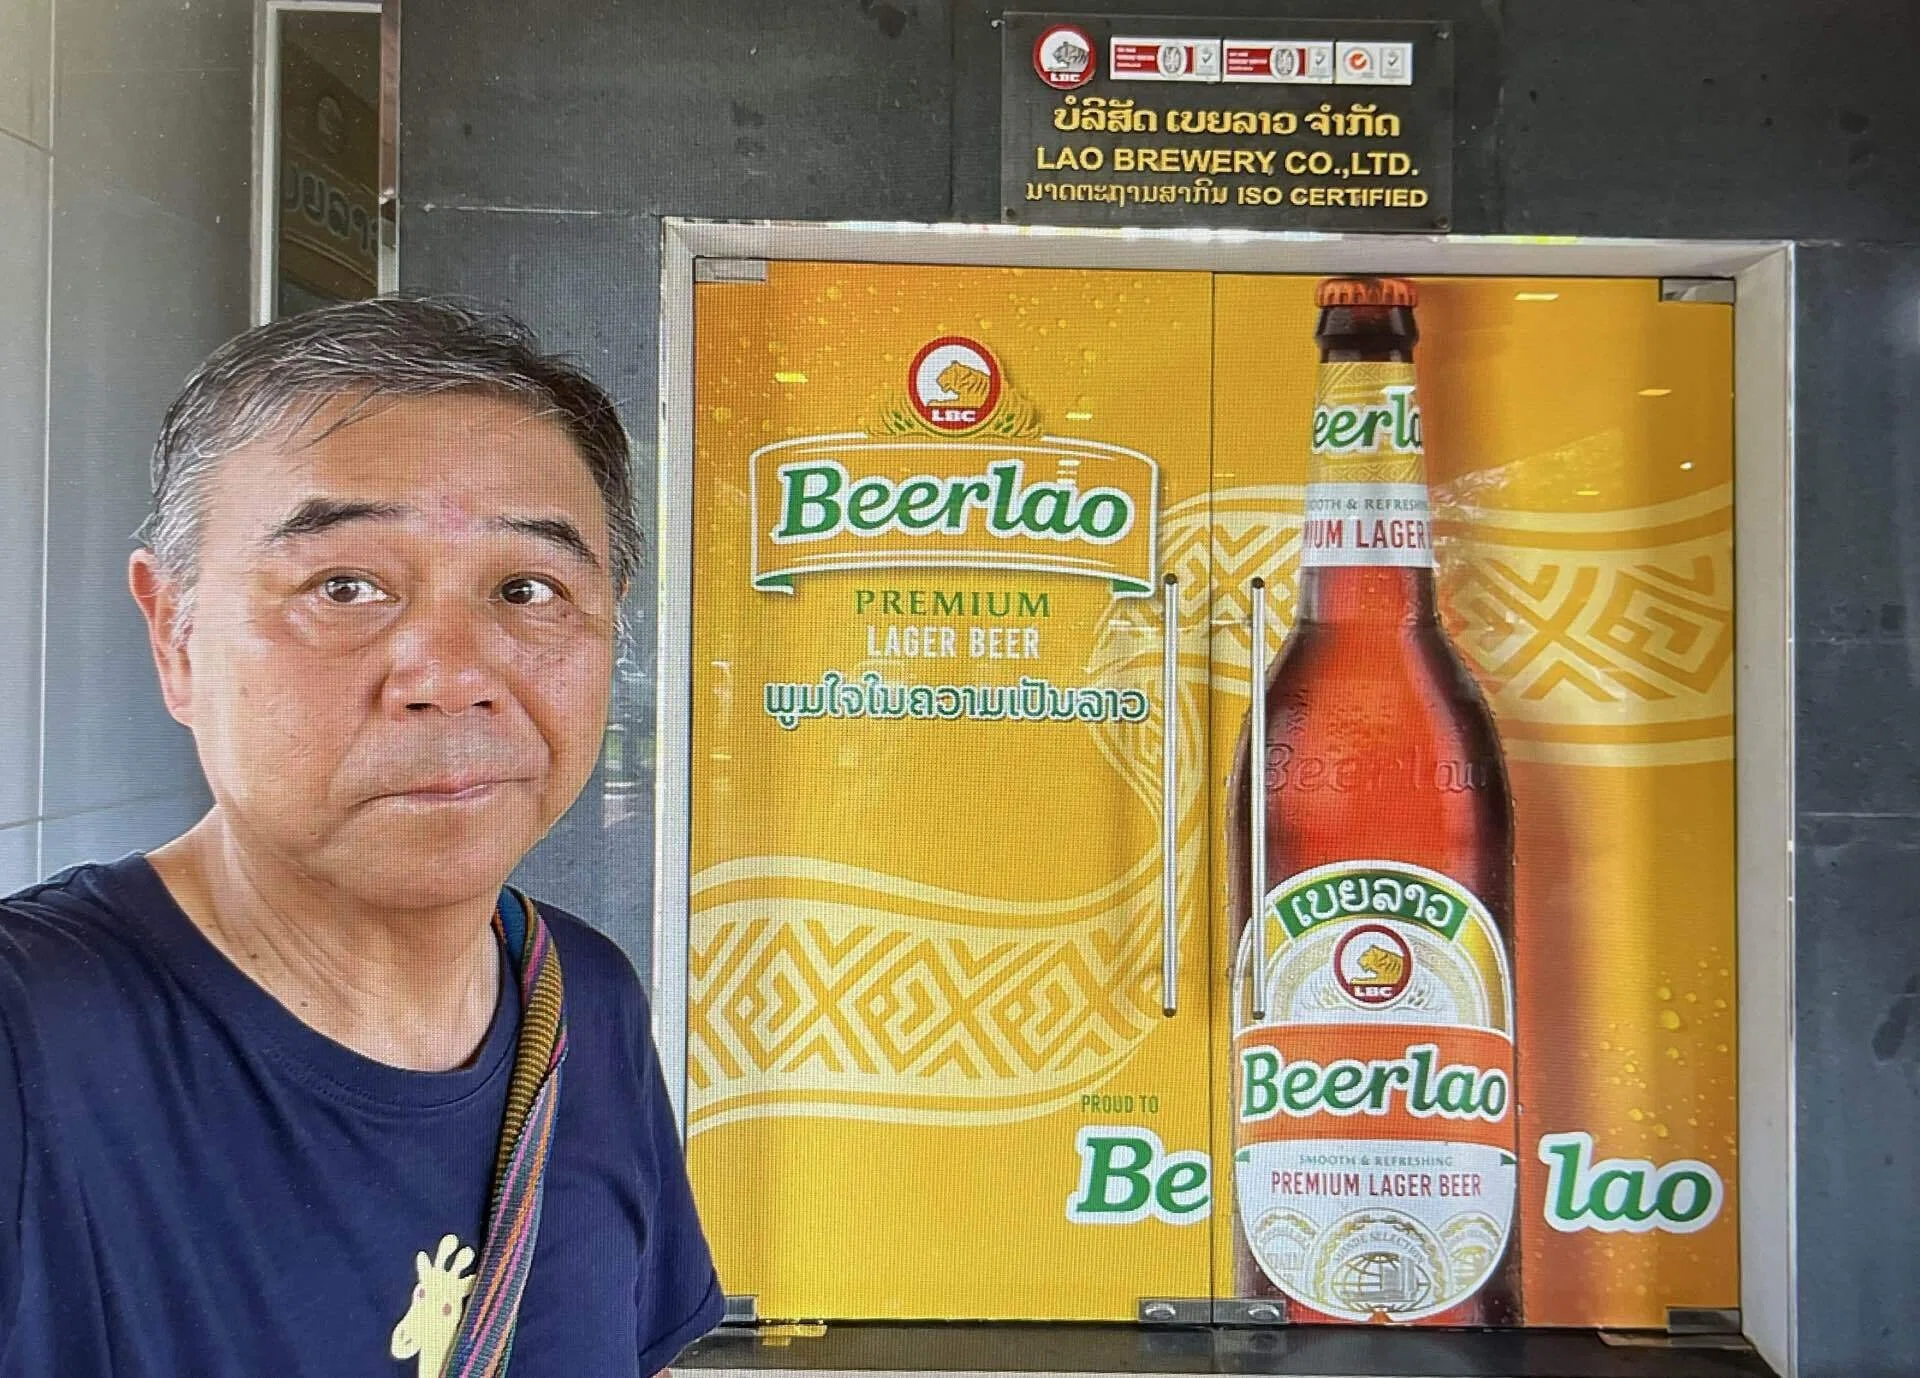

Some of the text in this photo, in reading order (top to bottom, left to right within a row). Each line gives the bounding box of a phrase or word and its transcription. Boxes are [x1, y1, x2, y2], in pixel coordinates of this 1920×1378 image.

[1166, 110, 1298, 136] ເບຍລາວ
[1036, 146, 1419, 178] LAO BREWERY CO.,LTD.
[1237, 186, 1282, 206] ISO
[1289, 187, 1429, 208] CERTIFIED
[931, 409, 977, 422] LBC
[772, 462, 1131, 541] Beerlao
[1346, 498, 1359, 511] &
[1356, 519, 1426, 550] LAGER
[854, 589, 1051, 617] PREMIUM
[866, 626, 1040, 660] LAGER BEER
[1290, 877, 1455, 928] ເບຍລາວ
[1240, 1048, 1507, 1120] Beerlao
[1081, 1094, 1160, 1114] PROUD TO
[1299, 1155, 1453, 1168] SMOOTH & REFRESHING
[1075, 1135, 1716, 1224] Be lao
[1271, 1170, 1482, 1198] PREMIUM LAGER BEER
